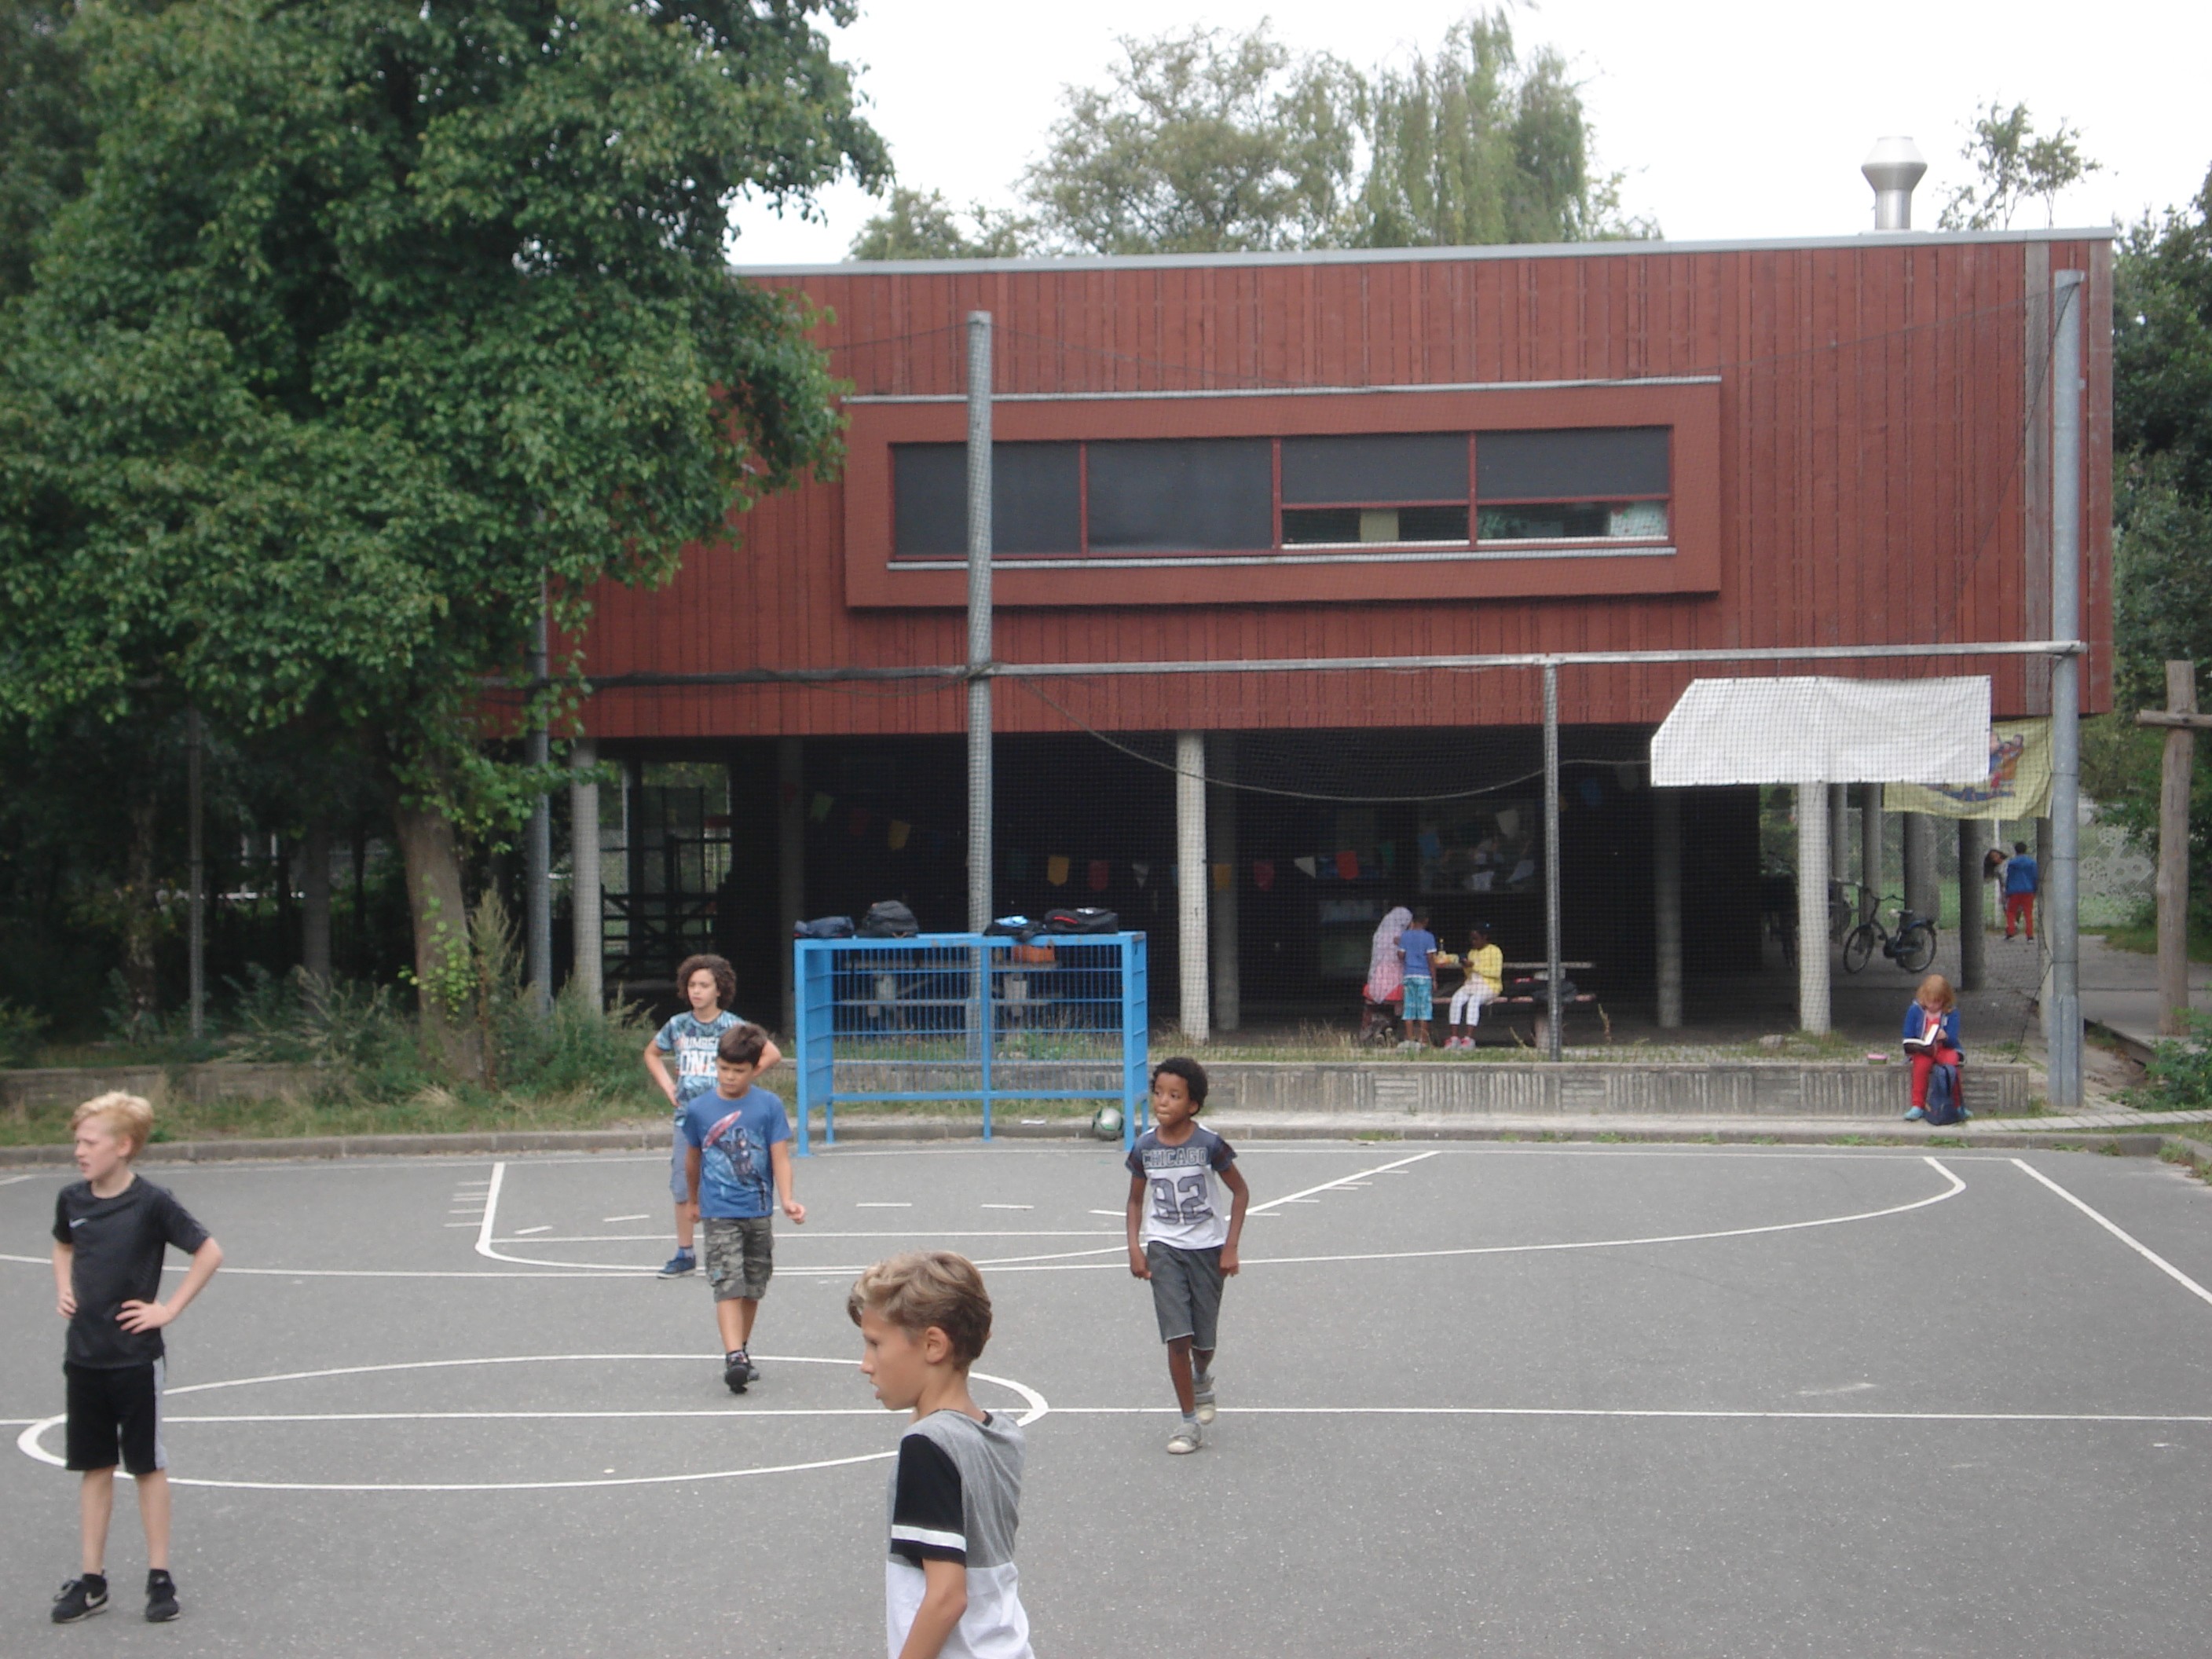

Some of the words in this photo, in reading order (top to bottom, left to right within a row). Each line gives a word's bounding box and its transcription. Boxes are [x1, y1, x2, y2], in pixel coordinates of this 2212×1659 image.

[679, 1049, 719, 1077] ONE
[1141, 1147, 1209, 1167] CHICAGO
[1150, 1174, 1214, 1225] 92
